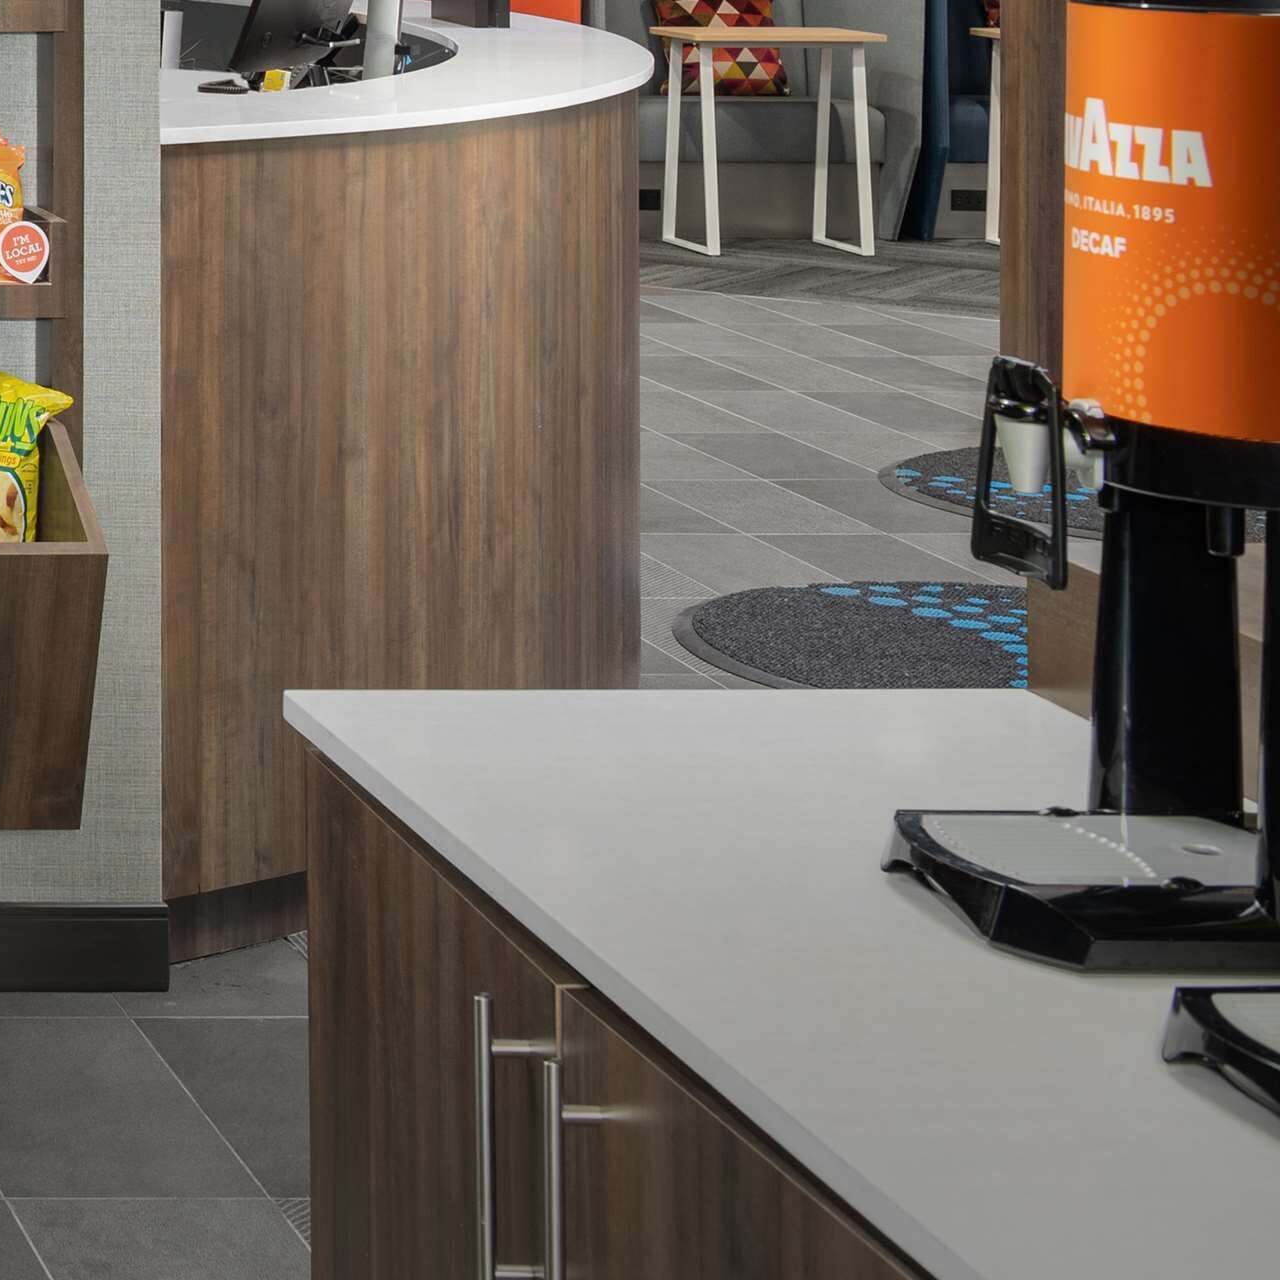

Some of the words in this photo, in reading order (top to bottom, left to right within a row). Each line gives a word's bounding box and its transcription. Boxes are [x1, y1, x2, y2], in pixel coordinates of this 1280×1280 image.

[1133, 204, 1175, 223] 1895
[12, 233, 30, 246] I'M
[1071, 227, 1127, 258] DECAF
[5, 242, 42, 260] LOCAL
